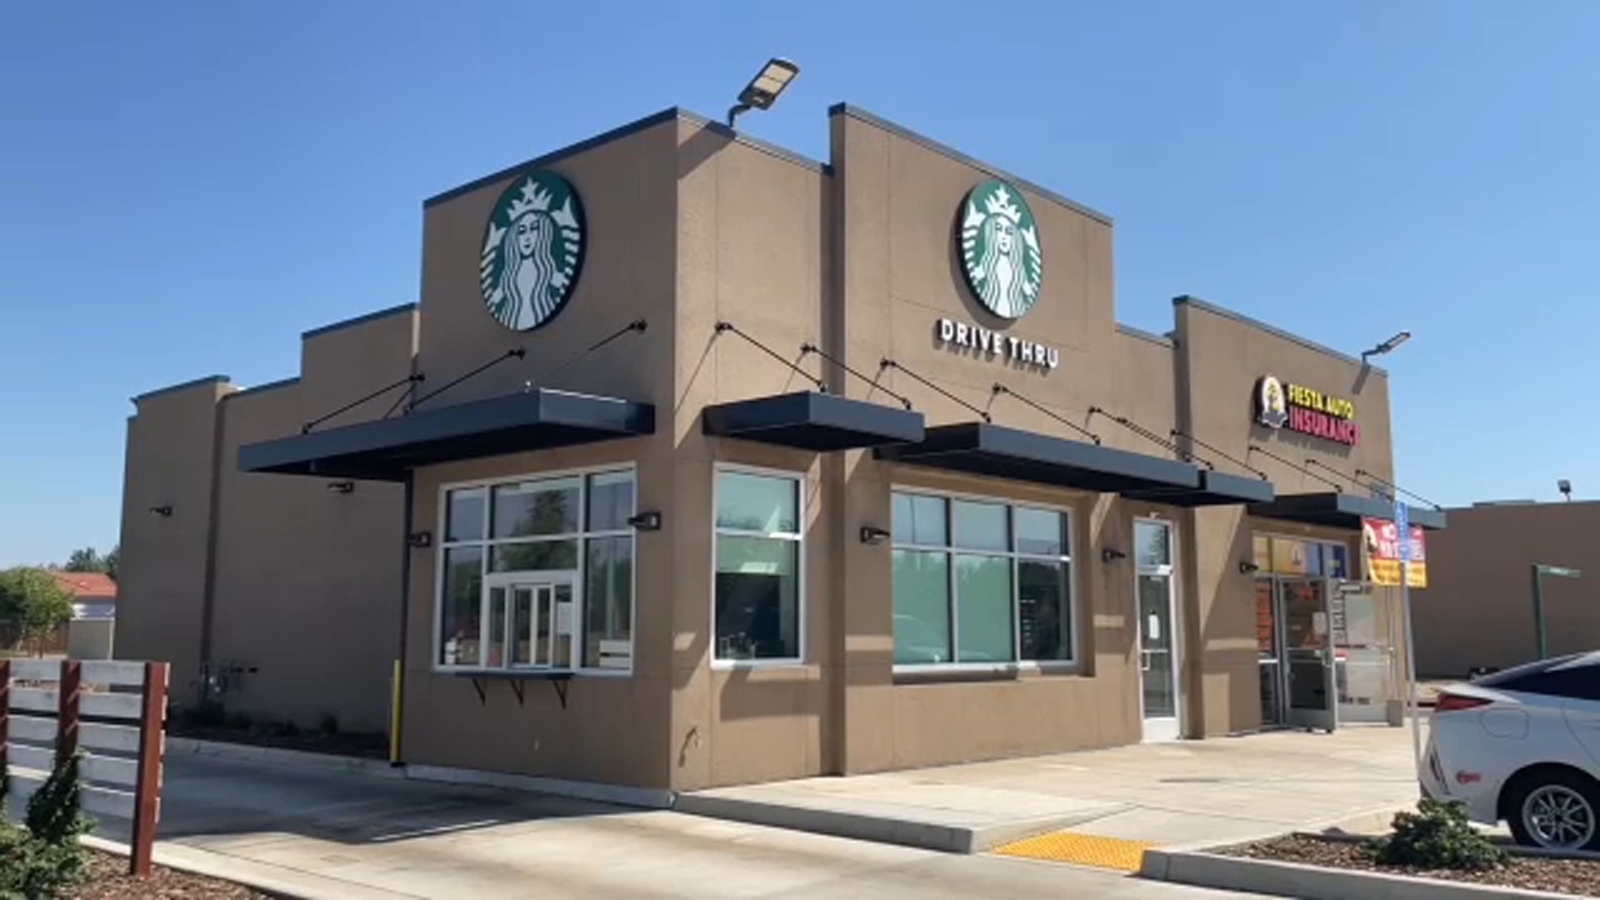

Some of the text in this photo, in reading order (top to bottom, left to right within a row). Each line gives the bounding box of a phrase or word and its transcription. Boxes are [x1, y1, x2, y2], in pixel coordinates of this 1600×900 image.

[941, 318, 1059, 368] DRIVE THRU
[1289, 384, 1354, 419] FIESTA AUTO
